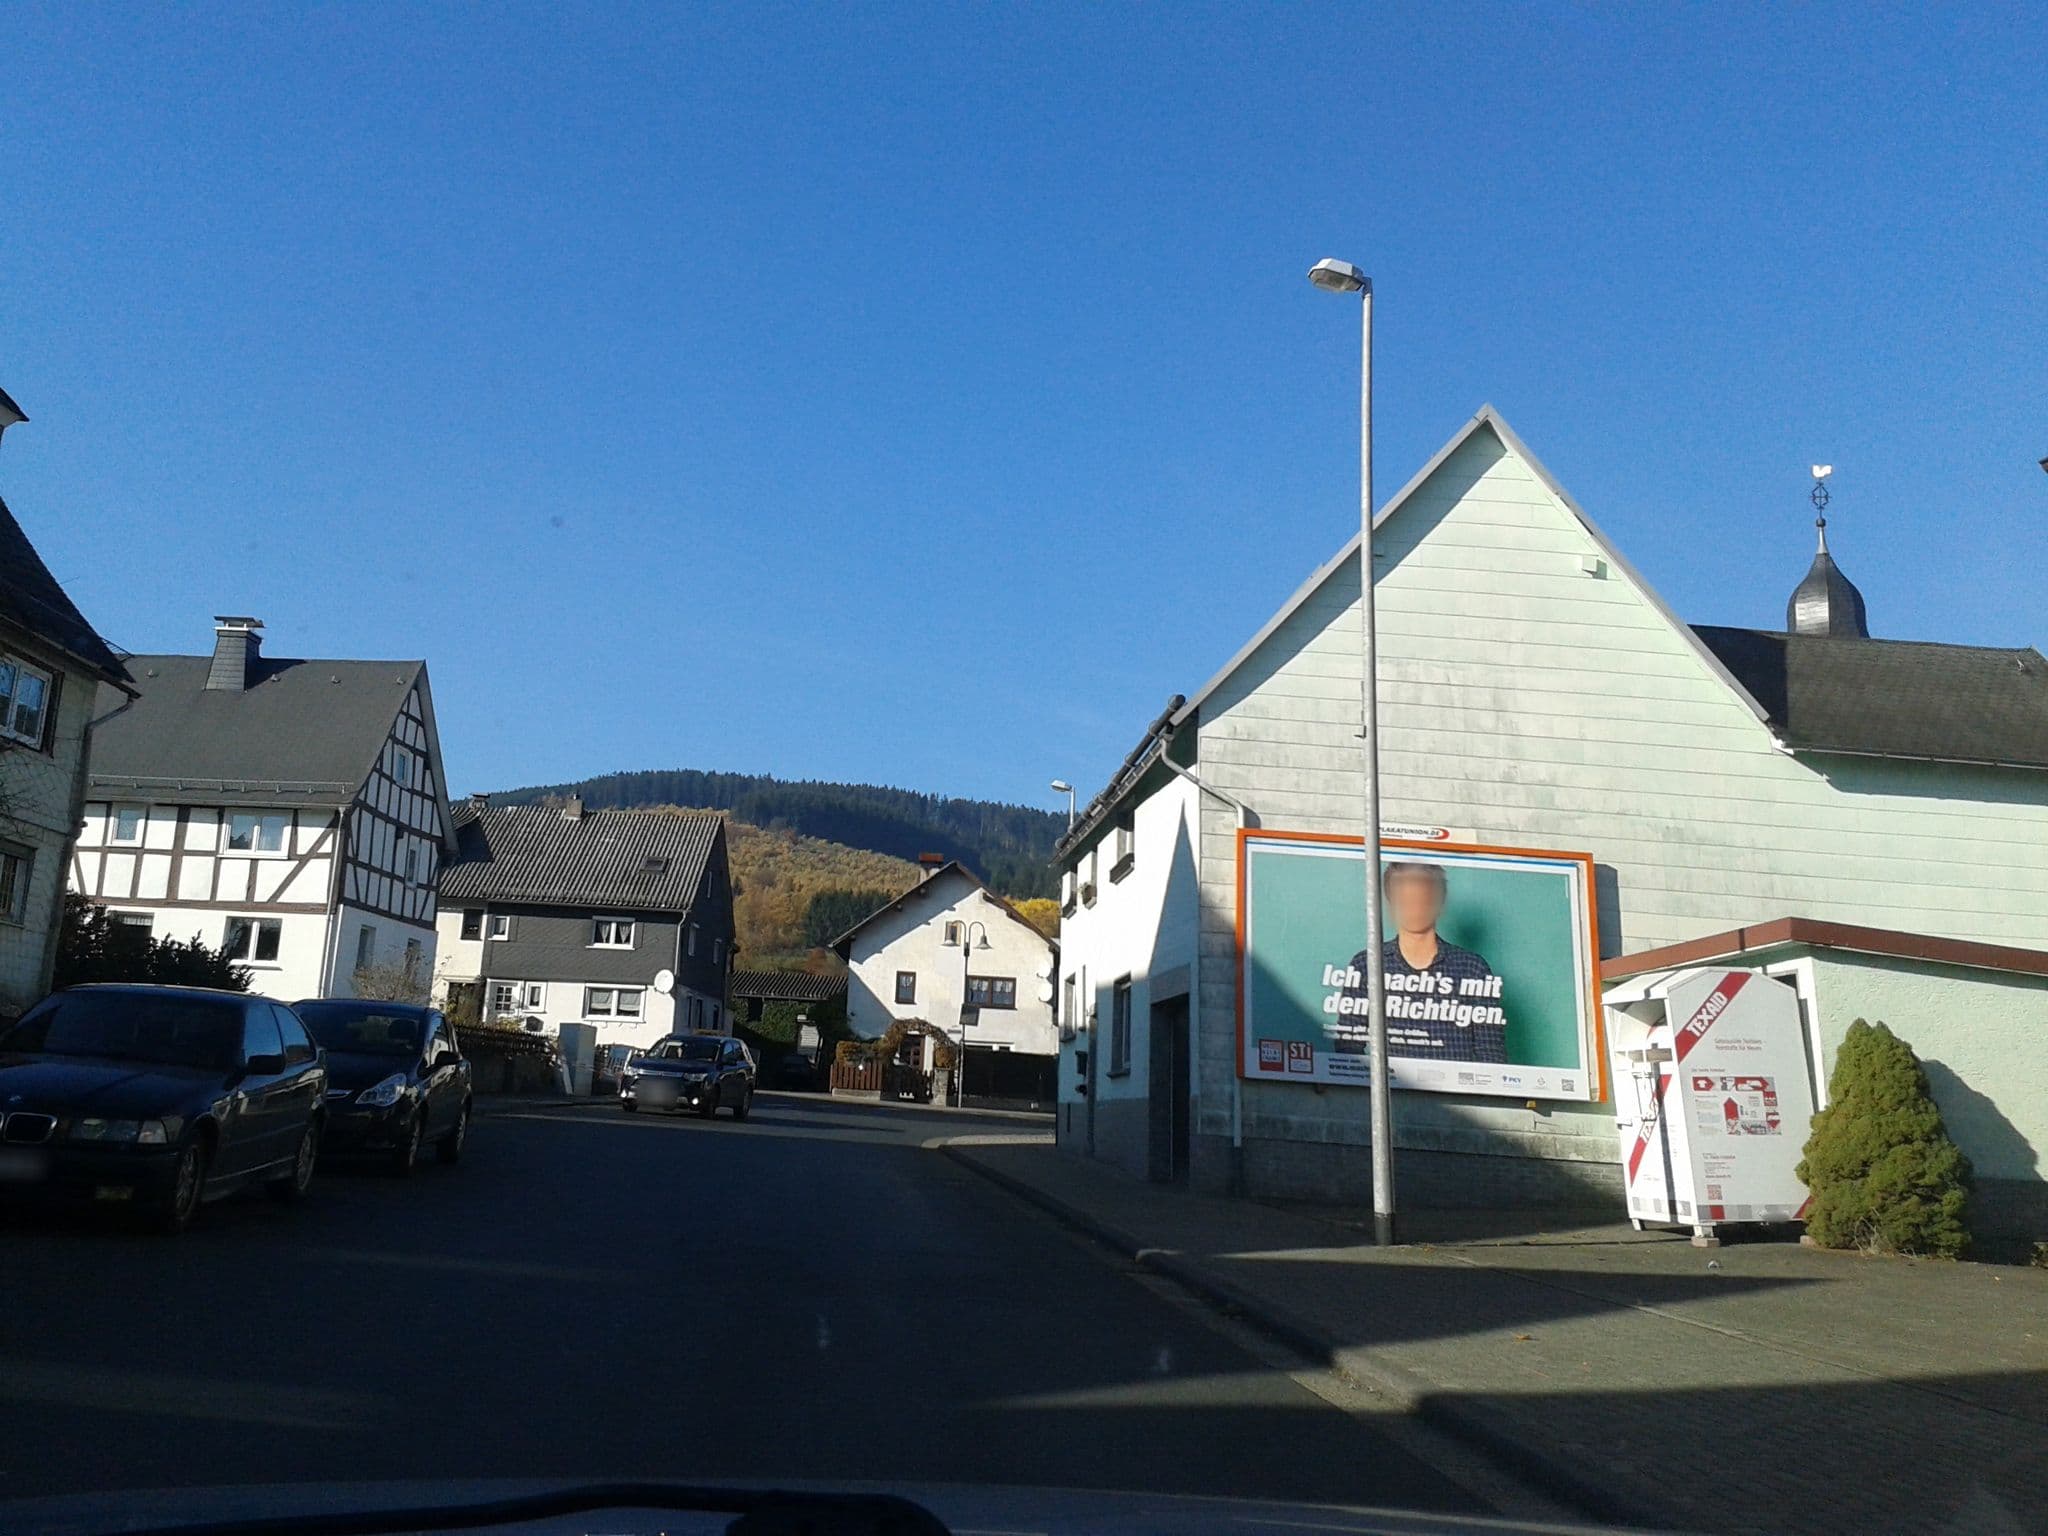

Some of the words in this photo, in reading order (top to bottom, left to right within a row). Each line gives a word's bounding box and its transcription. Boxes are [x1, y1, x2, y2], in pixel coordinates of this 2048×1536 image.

[1322, 964, 1362, 988] Ich
[1383, 970, 1454, 995] ach's
[1459, 974, 1503, 998] mit
[1385, 995, 1507, 1027] Richtigen.
[1685, 991, 1729, 1038] TEXAID
